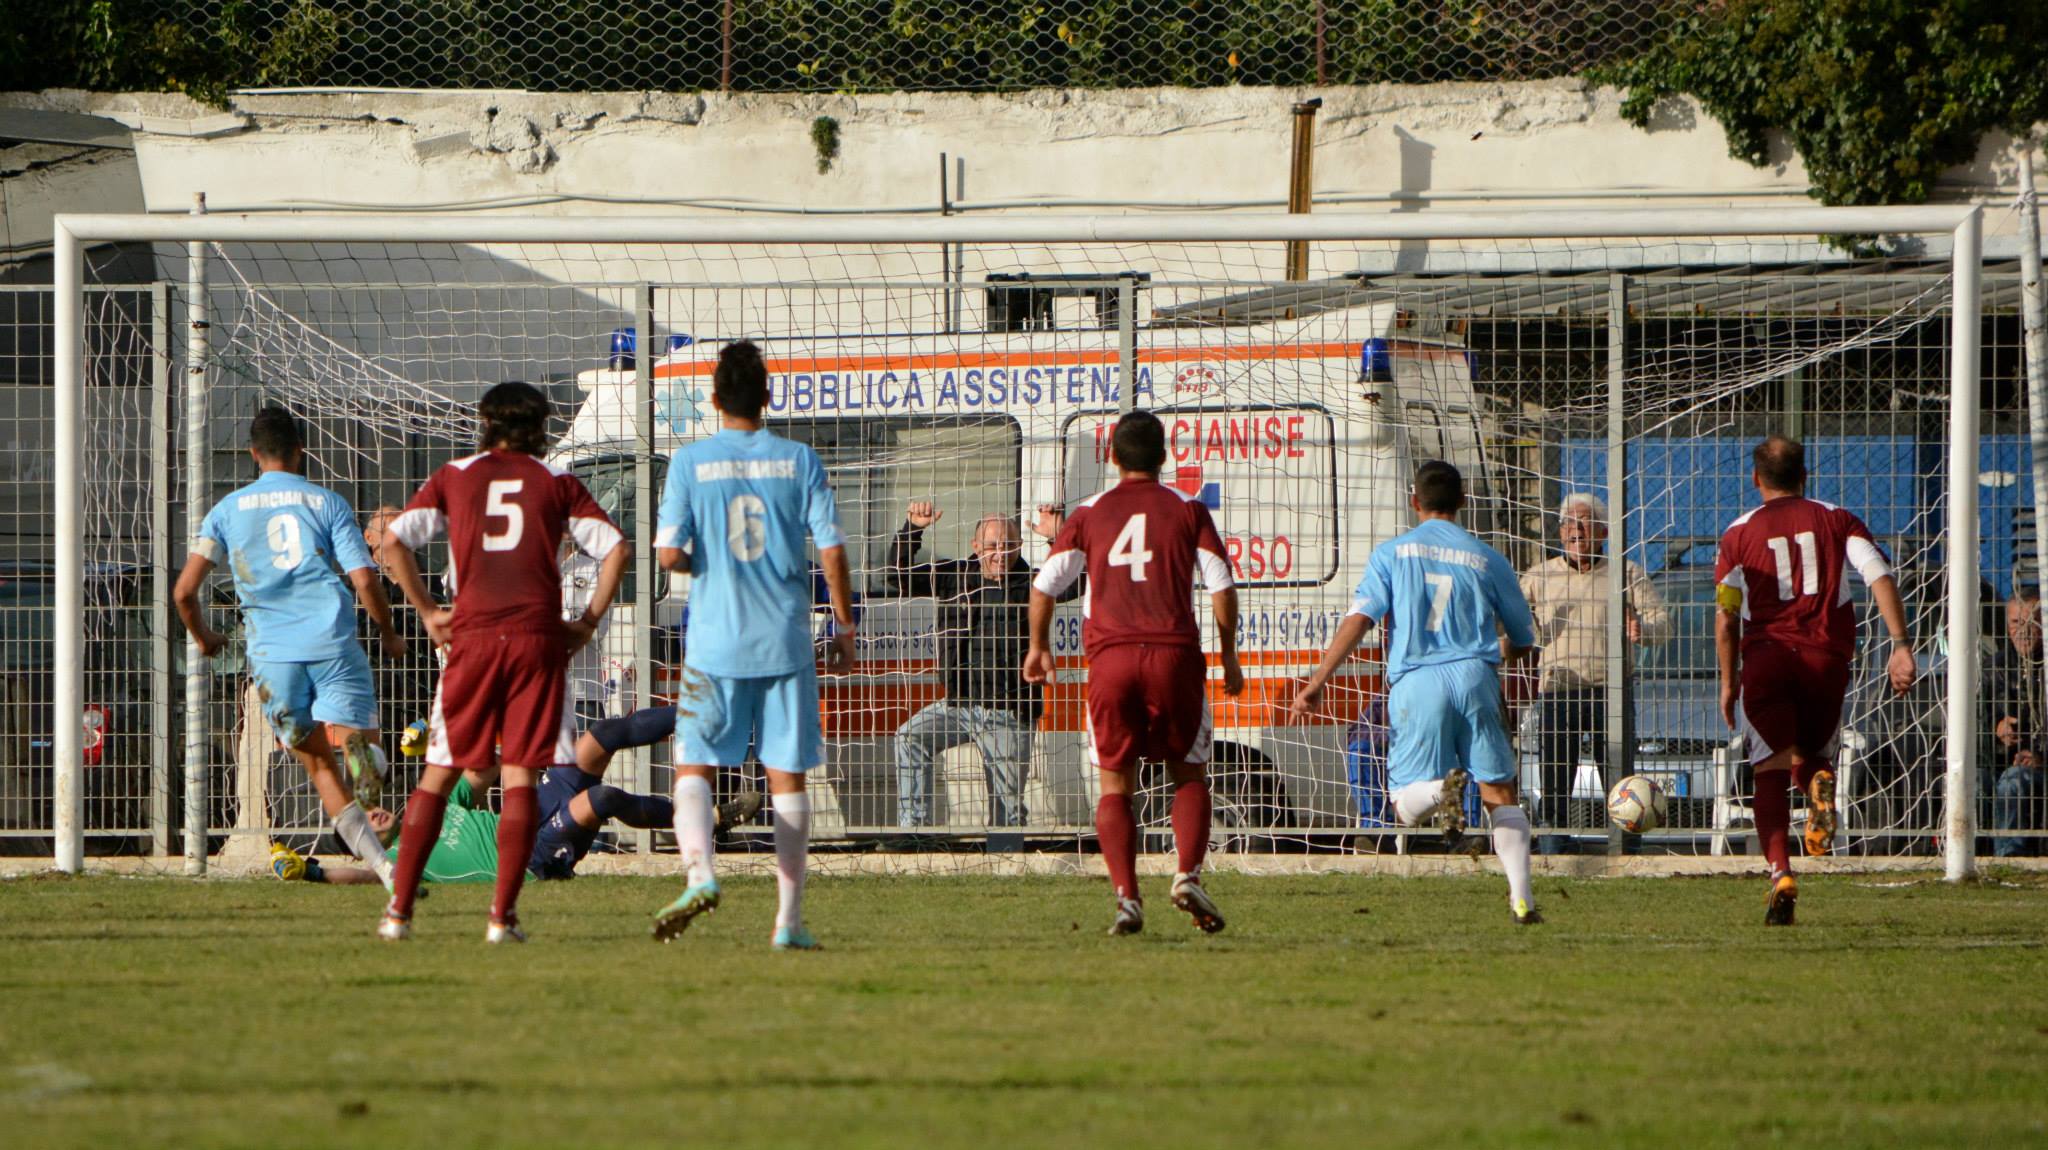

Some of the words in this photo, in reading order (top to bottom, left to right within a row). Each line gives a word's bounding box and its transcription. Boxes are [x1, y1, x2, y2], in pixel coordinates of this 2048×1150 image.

[769, 371, 924, 411] UBBLICA
[1095, 415, 1305, 464] MCIANISE
[238, 488, 325, 512] MARCIANSE
[482, 479, 525, 552] 5
[728, 495, 768, 562] 6
[266, 513, 304, 571] 9
[1107, 513, 1153, 583] 4
[1395, 543, 1489, 573] MARCIANISE
[1767, 531, 1820, 601] 11
[1424, 572, 1454, 632] 7
